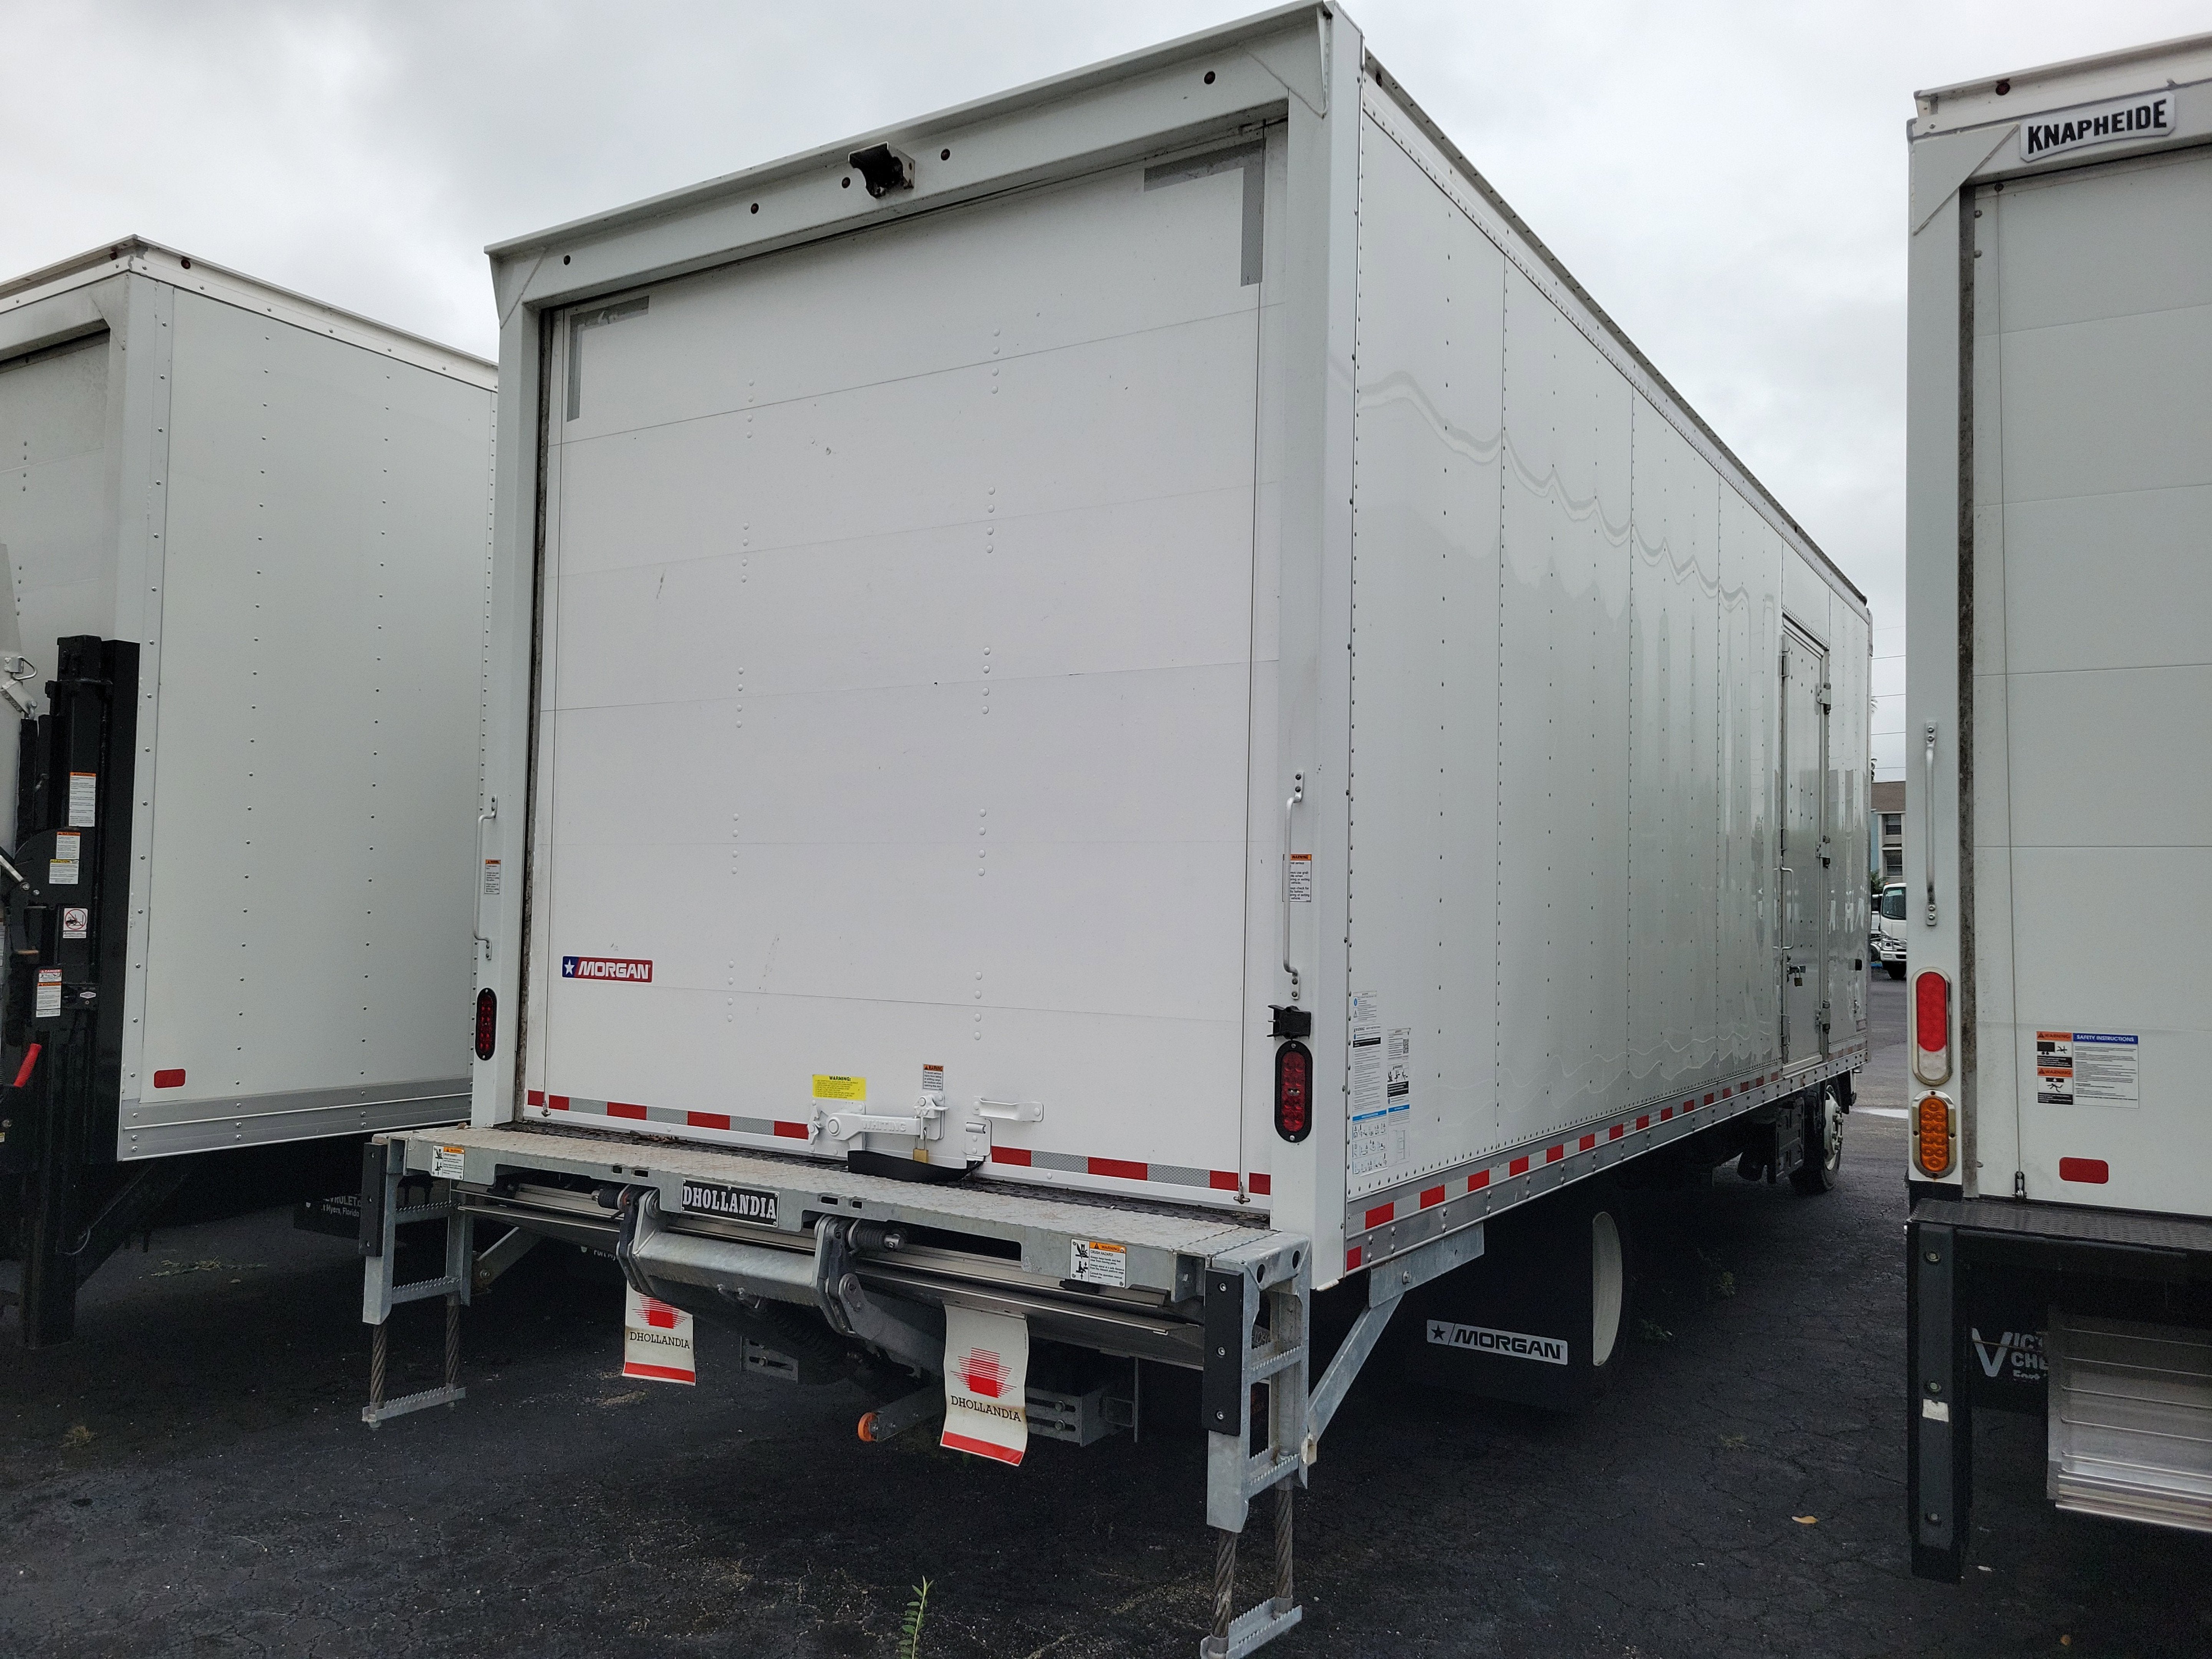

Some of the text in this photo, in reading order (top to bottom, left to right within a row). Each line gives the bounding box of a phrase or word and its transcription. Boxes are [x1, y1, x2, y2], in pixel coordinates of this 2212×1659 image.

[2028, 99, 2167, 154] KNAPHEIDE
[578, 961, 649, 979] MORGAN
[861, 1119, 906, 1132] WHITING
[683, 1186, 776, 1219] DHOLLANDIA
[630, 1331, 690, 1349] DHOLLANDIA
[1454, 1329, 1561, 1359] MORGAN
[950, 1395, 1021, 1422] DHOLLANDIA
